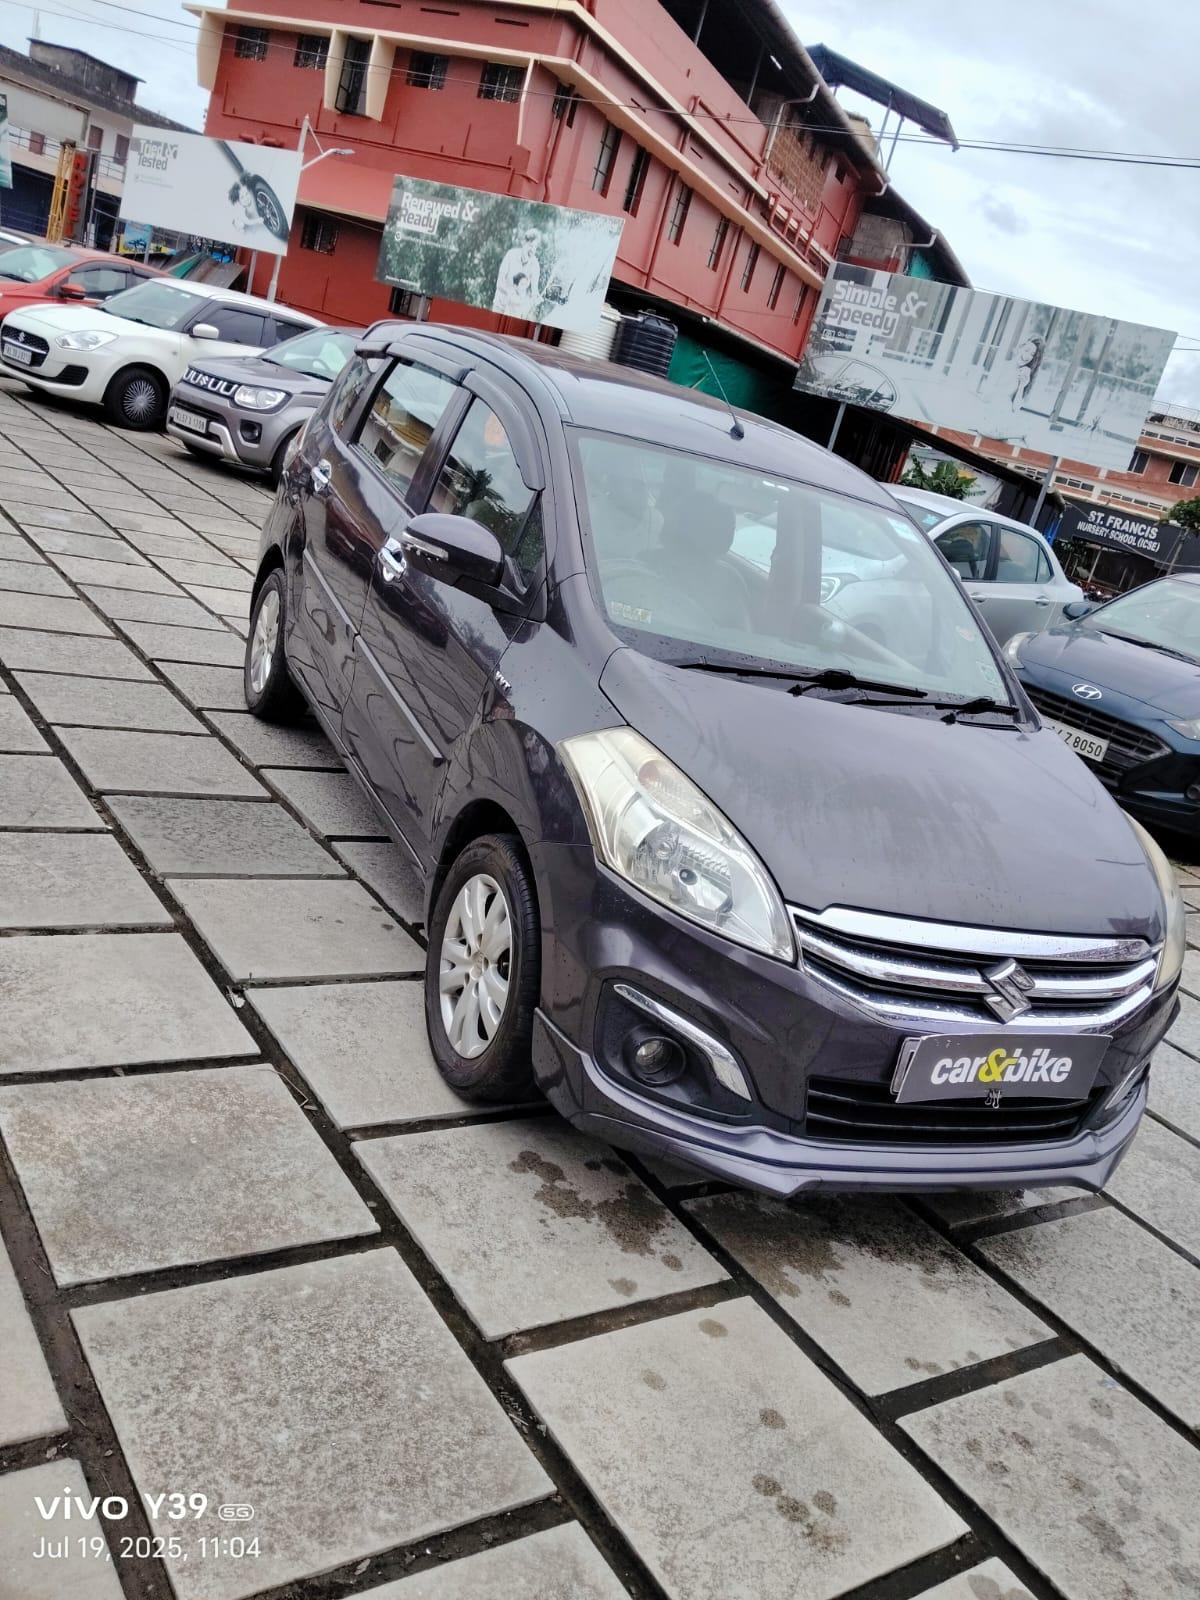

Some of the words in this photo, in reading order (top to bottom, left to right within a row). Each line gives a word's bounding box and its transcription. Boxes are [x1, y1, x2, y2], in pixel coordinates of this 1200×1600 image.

[137, 152, 168, 170] Tested
[399, 208, 438, 233] Ready
[401, 191, 461, 219] Renewed
[461, 200, 480, 222] &
[832, 280, 897, 311] Simple
[900, 291, 928, 318] &
[827, 301, 897, 337] Speedy
[1076, 521, 1110, 538] NURSERY
[1109, 530, 1137, 546] SCHOOL
[1137, 538, 1161, 553] (ICSE)
[1088, 510, 1105, 525] ST.
[1105, 515, 1159, 540] FRANCIS
[930, 1048, 1073, 1085] car&bike
